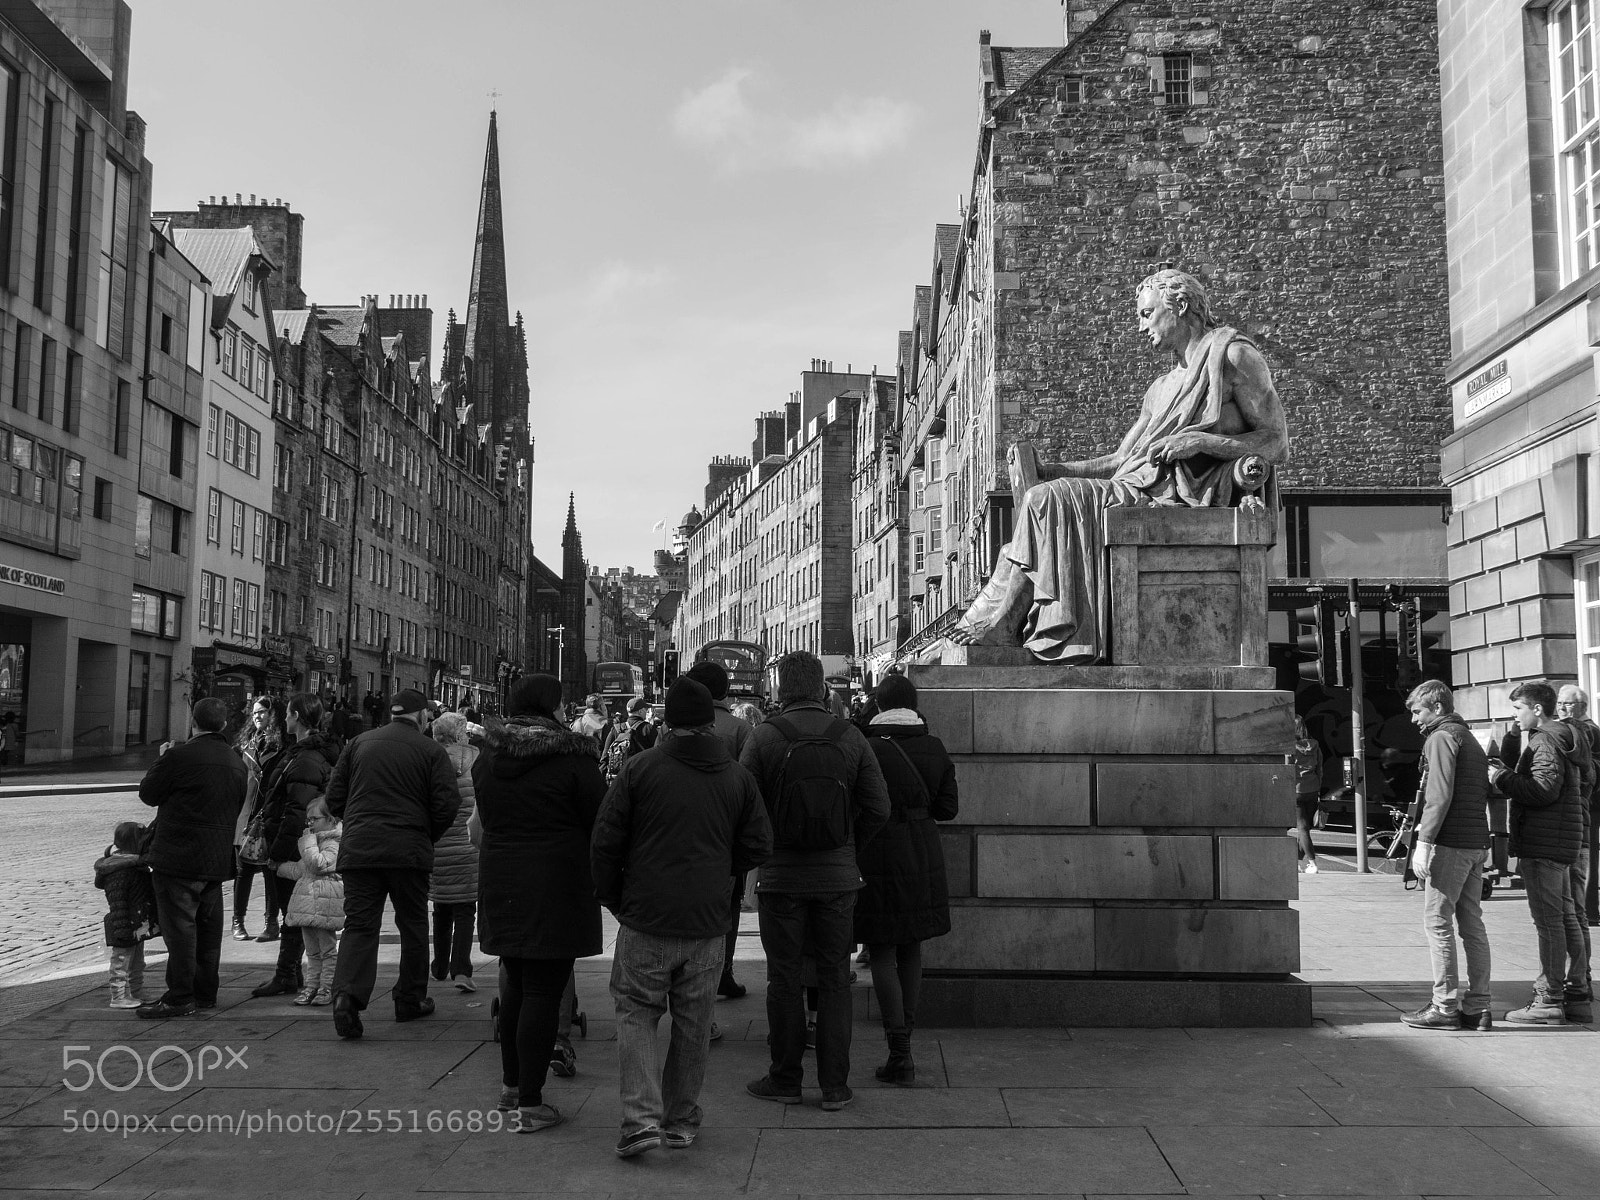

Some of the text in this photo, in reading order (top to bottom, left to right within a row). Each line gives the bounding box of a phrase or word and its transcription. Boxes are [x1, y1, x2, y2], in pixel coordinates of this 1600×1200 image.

[1469, 362, 1505, 393] ROYAL MILE
[0, 564, 65, 593] NK OF SCOTLAND
